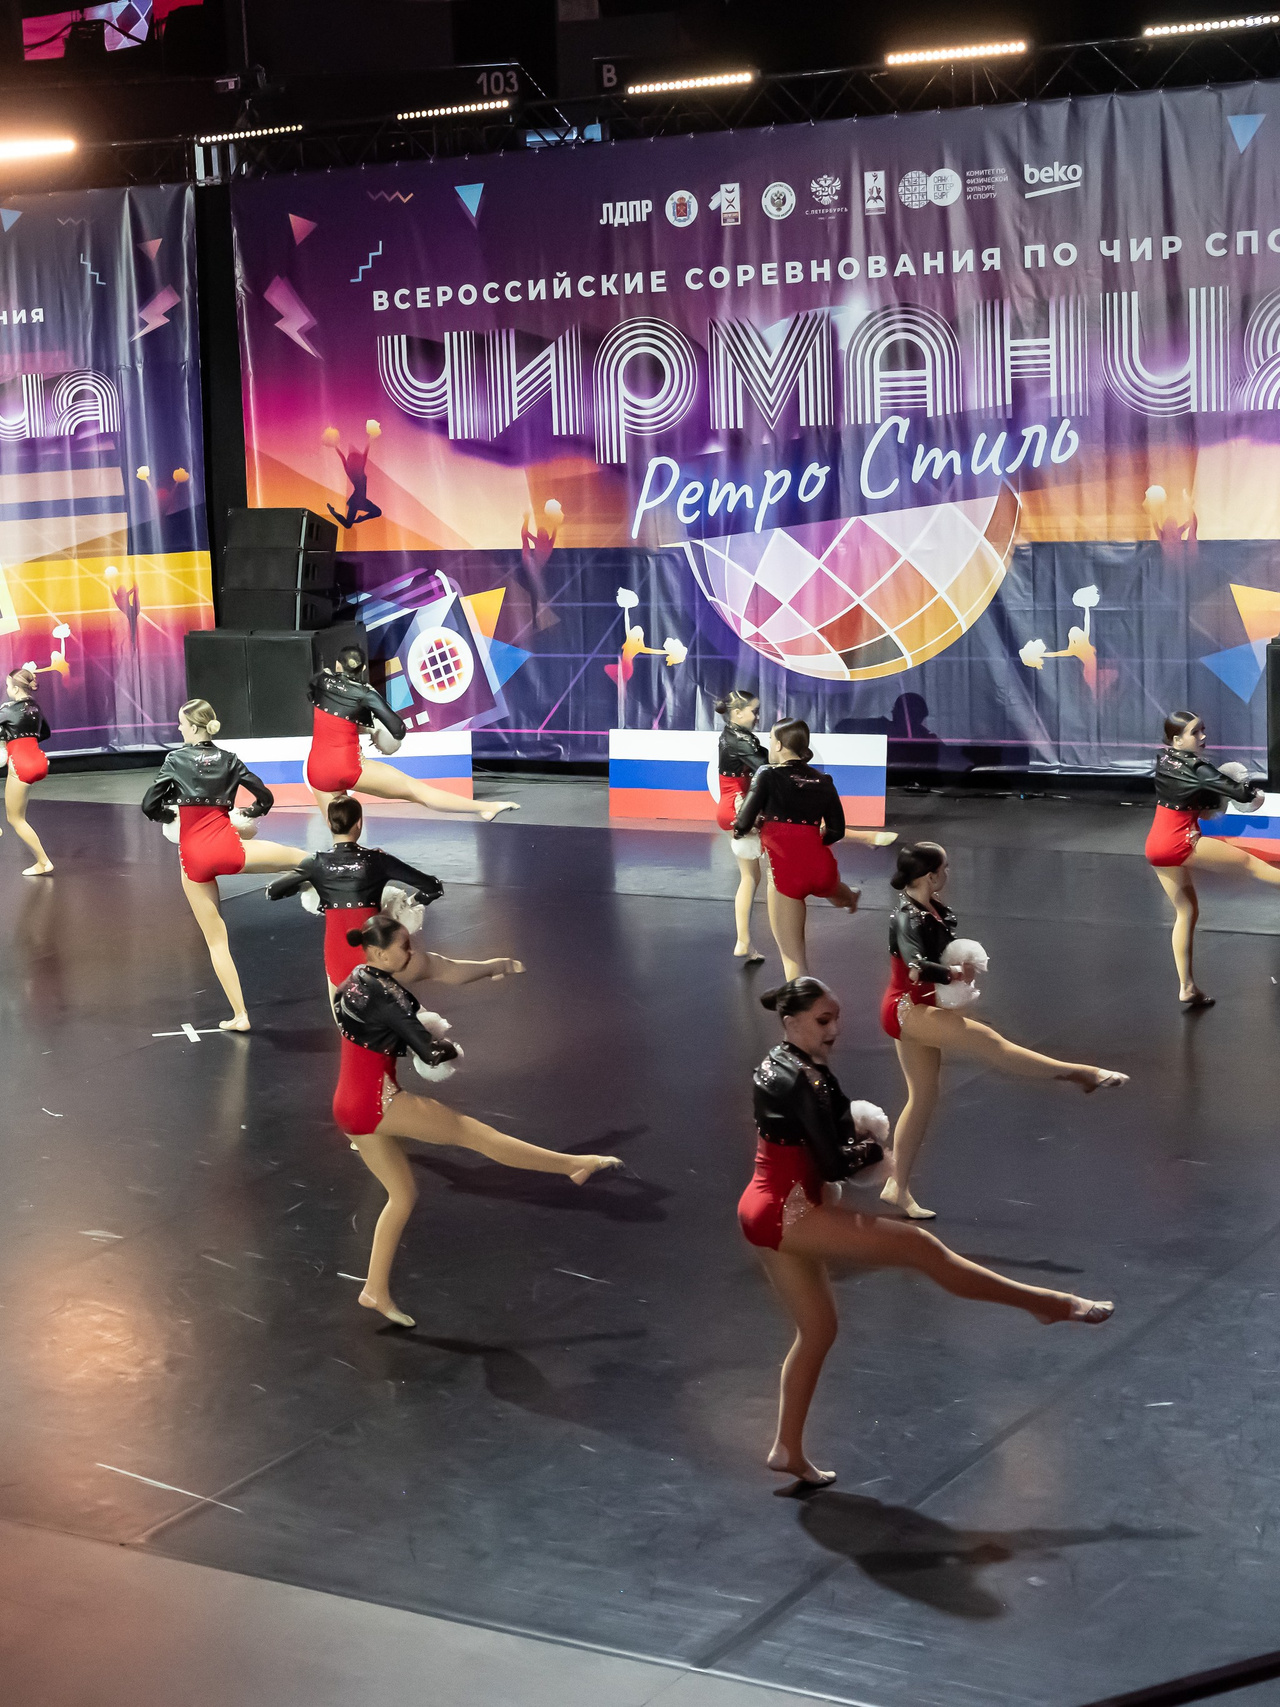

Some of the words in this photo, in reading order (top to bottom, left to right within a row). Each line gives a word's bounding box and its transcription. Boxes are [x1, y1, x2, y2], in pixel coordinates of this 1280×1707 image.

[476, 71, 519, 96] 103
[1023, 161, 1083, 185] beko
[599, 200, 653, 227] ЛДПР
[372, 270, 667, 311] ВСЕРОССИЙСКИЕ
[685, 247, 1001, 290] СОРЕВНОВАНИЯ
[1024, 242, 1078, 269] ПО
[1099, 235, 1183, 263] ЧИР
[631, 456, 831, 540] Ретро
[860, 415, 1079, 499] Стиль
